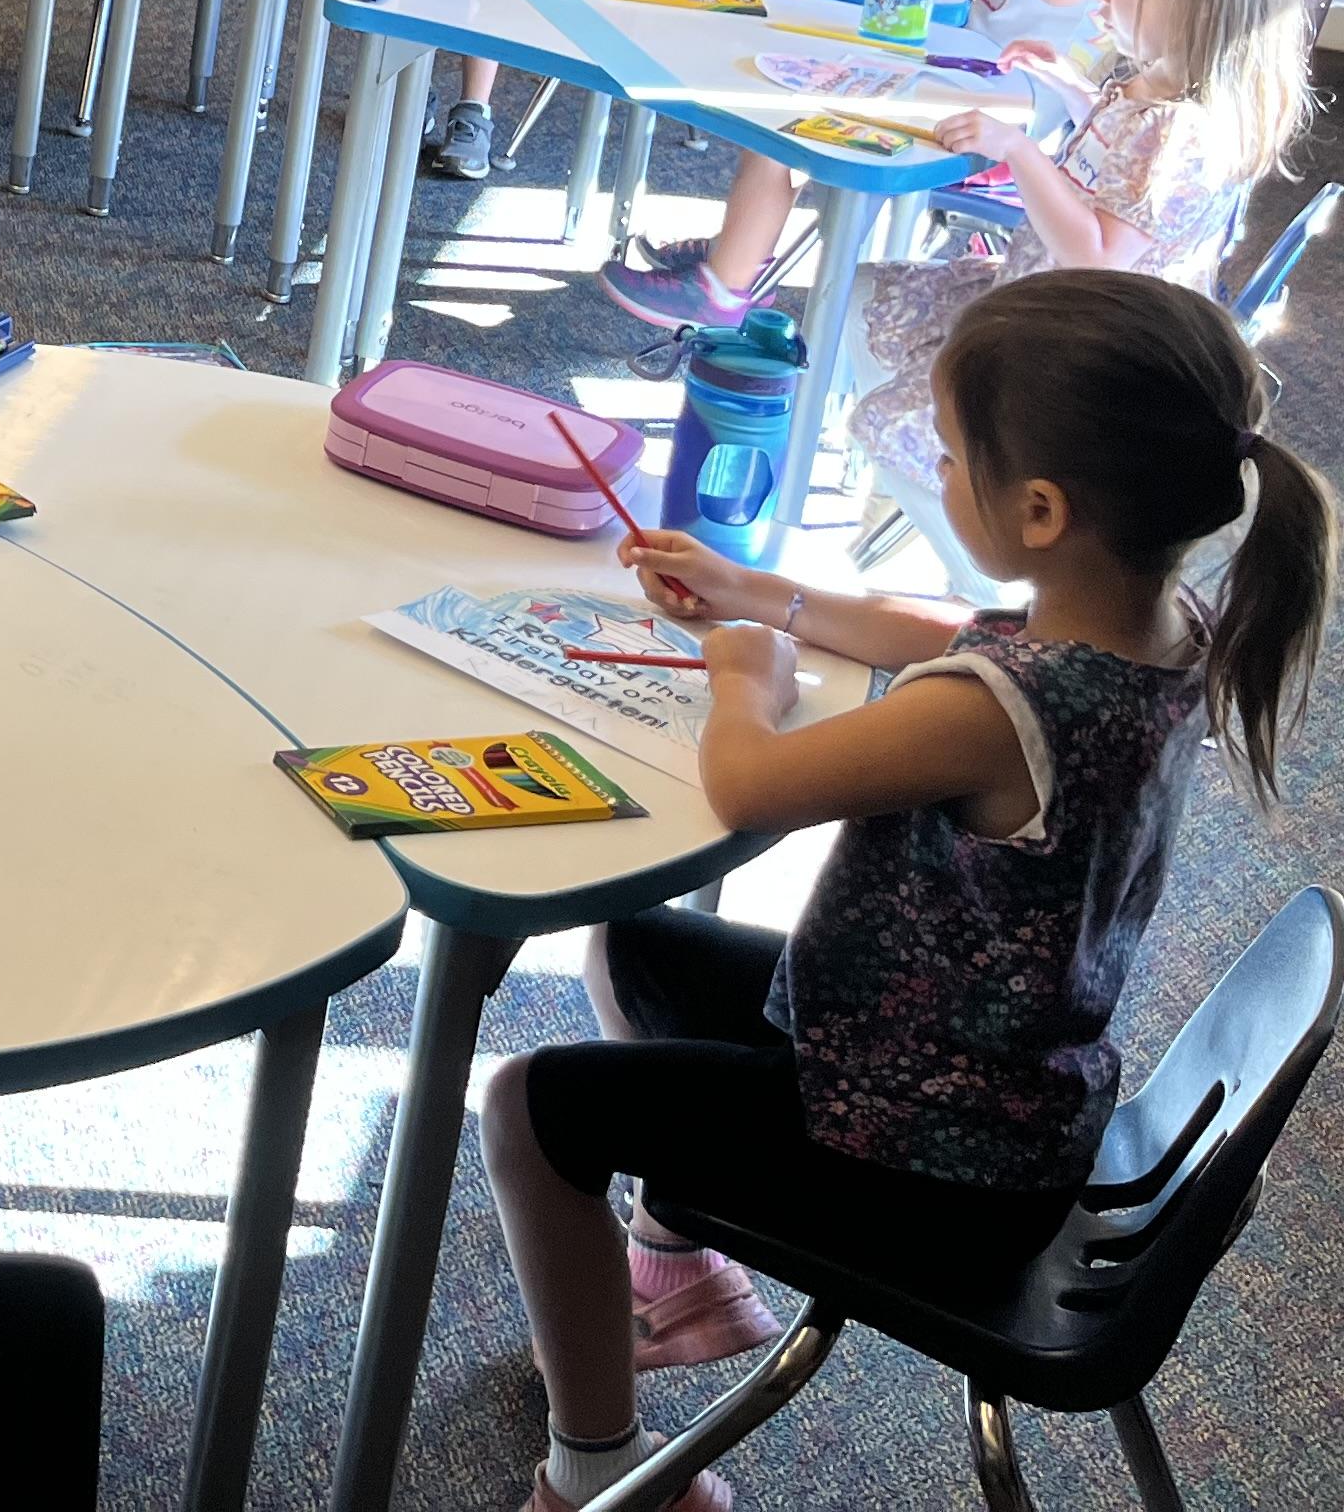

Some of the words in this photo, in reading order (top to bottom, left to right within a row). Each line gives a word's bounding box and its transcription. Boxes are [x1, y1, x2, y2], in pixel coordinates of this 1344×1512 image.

[447, 627, 670, 730] Kindergarten!
[488, 627, 558, 661] First
[559, 659, 617, 688] Day
[622, 688, 664, 705] of
[491, 613, 515, 625] I
[647, 679, 693, 705] the
[328, 773, 359, 794] 12
[363, 750, 445, 813] PENCILS
[383, 744, 472, 816] COLORED
[510, 745, 570, 797] Crayola
